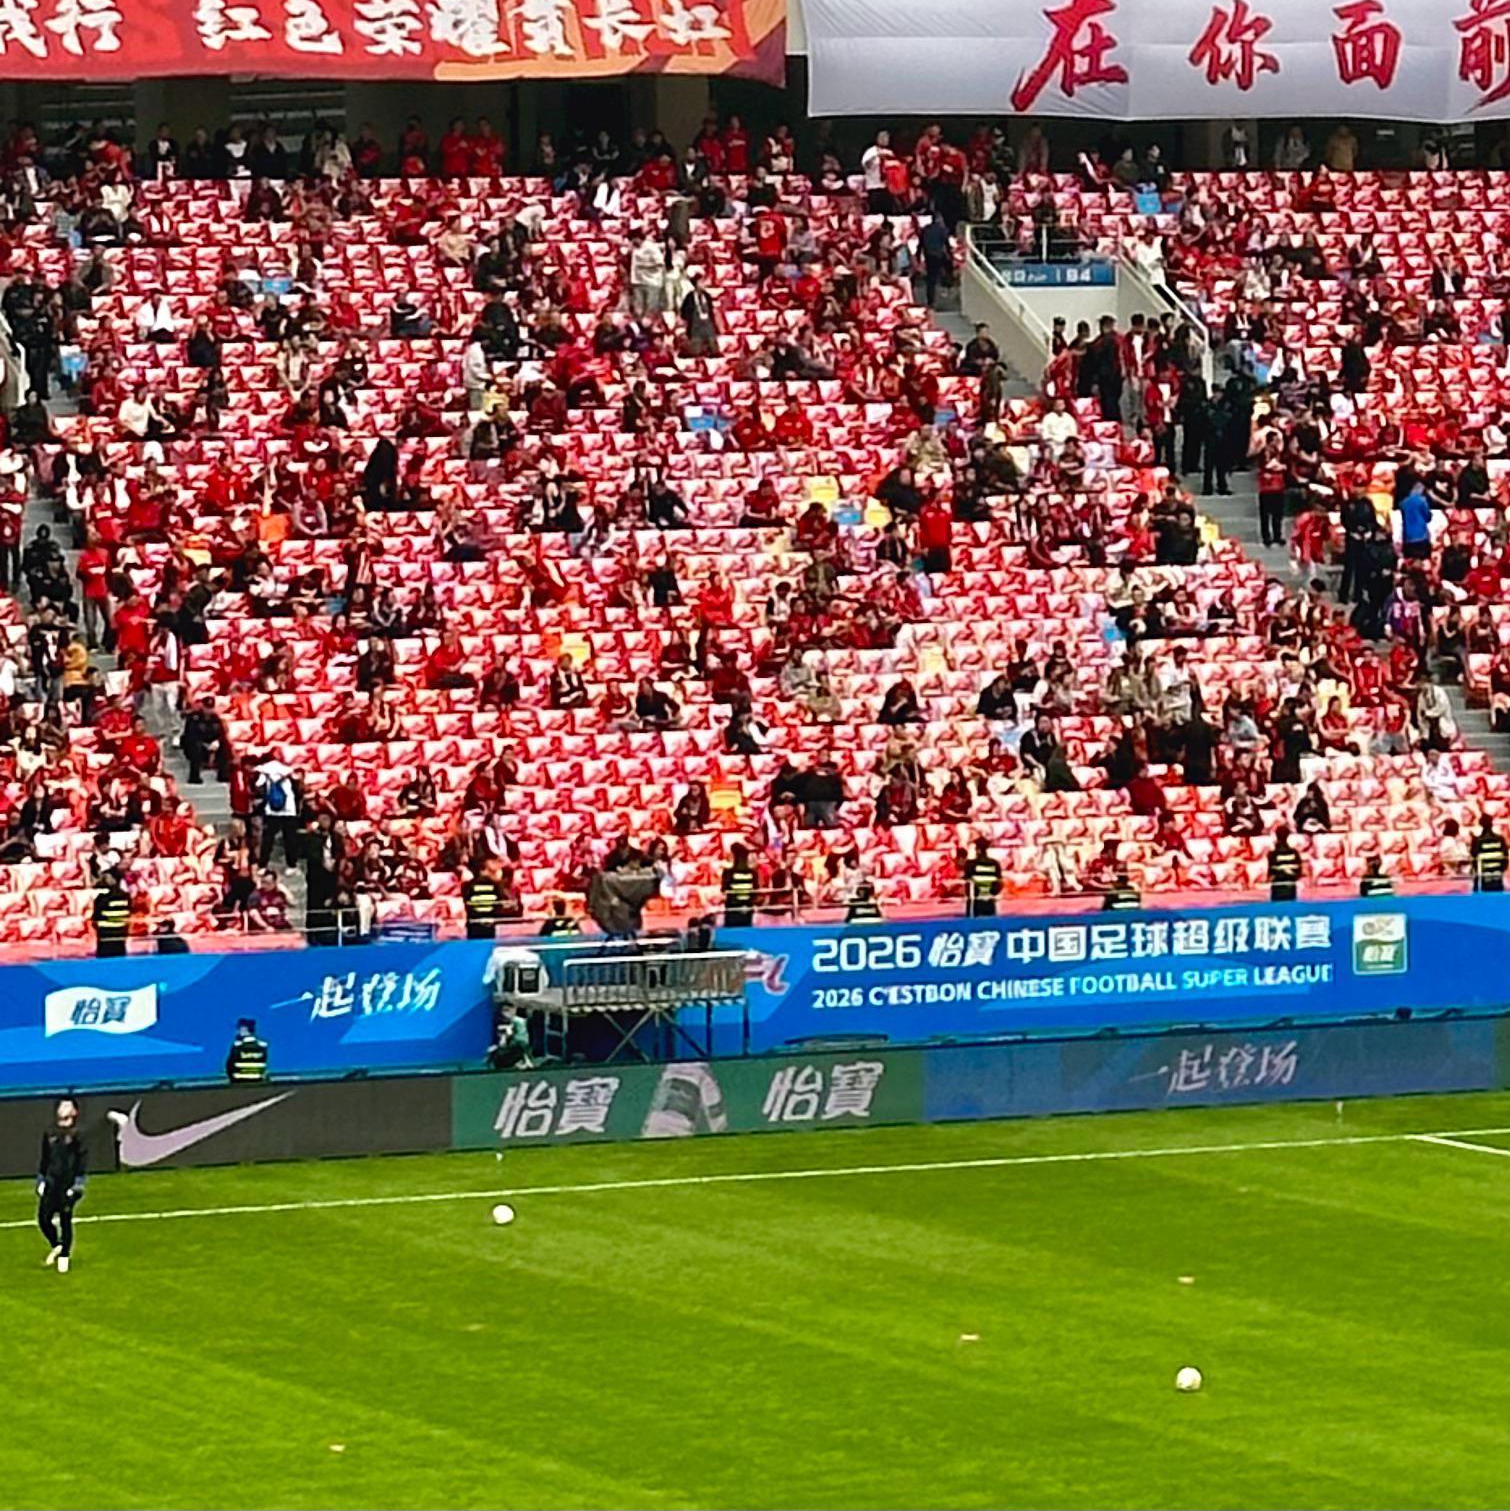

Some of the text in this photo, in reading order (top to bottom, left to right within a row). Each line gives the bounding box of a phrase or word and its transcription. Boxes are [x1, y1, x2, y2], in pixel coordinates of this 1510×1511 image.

[811, 934, 922, 973] 2026
[1006, 915, 1332, 965] 中国足球超级联赛
[70, 996, 133, 1025] 怡寶
[811, 988, 864, 1009] 2026
[976, 977, 1065, 1001] CHINESE
[1069, 971, 1178, 995] FOOTBALL
[1182, 967, 1249, 990] SUPER
[1253, 963, 1334, 985] LEAGUE
[494, 1076, 620, 1139] 怡寶
[762, 1060, 885, 1123] 怡寶
